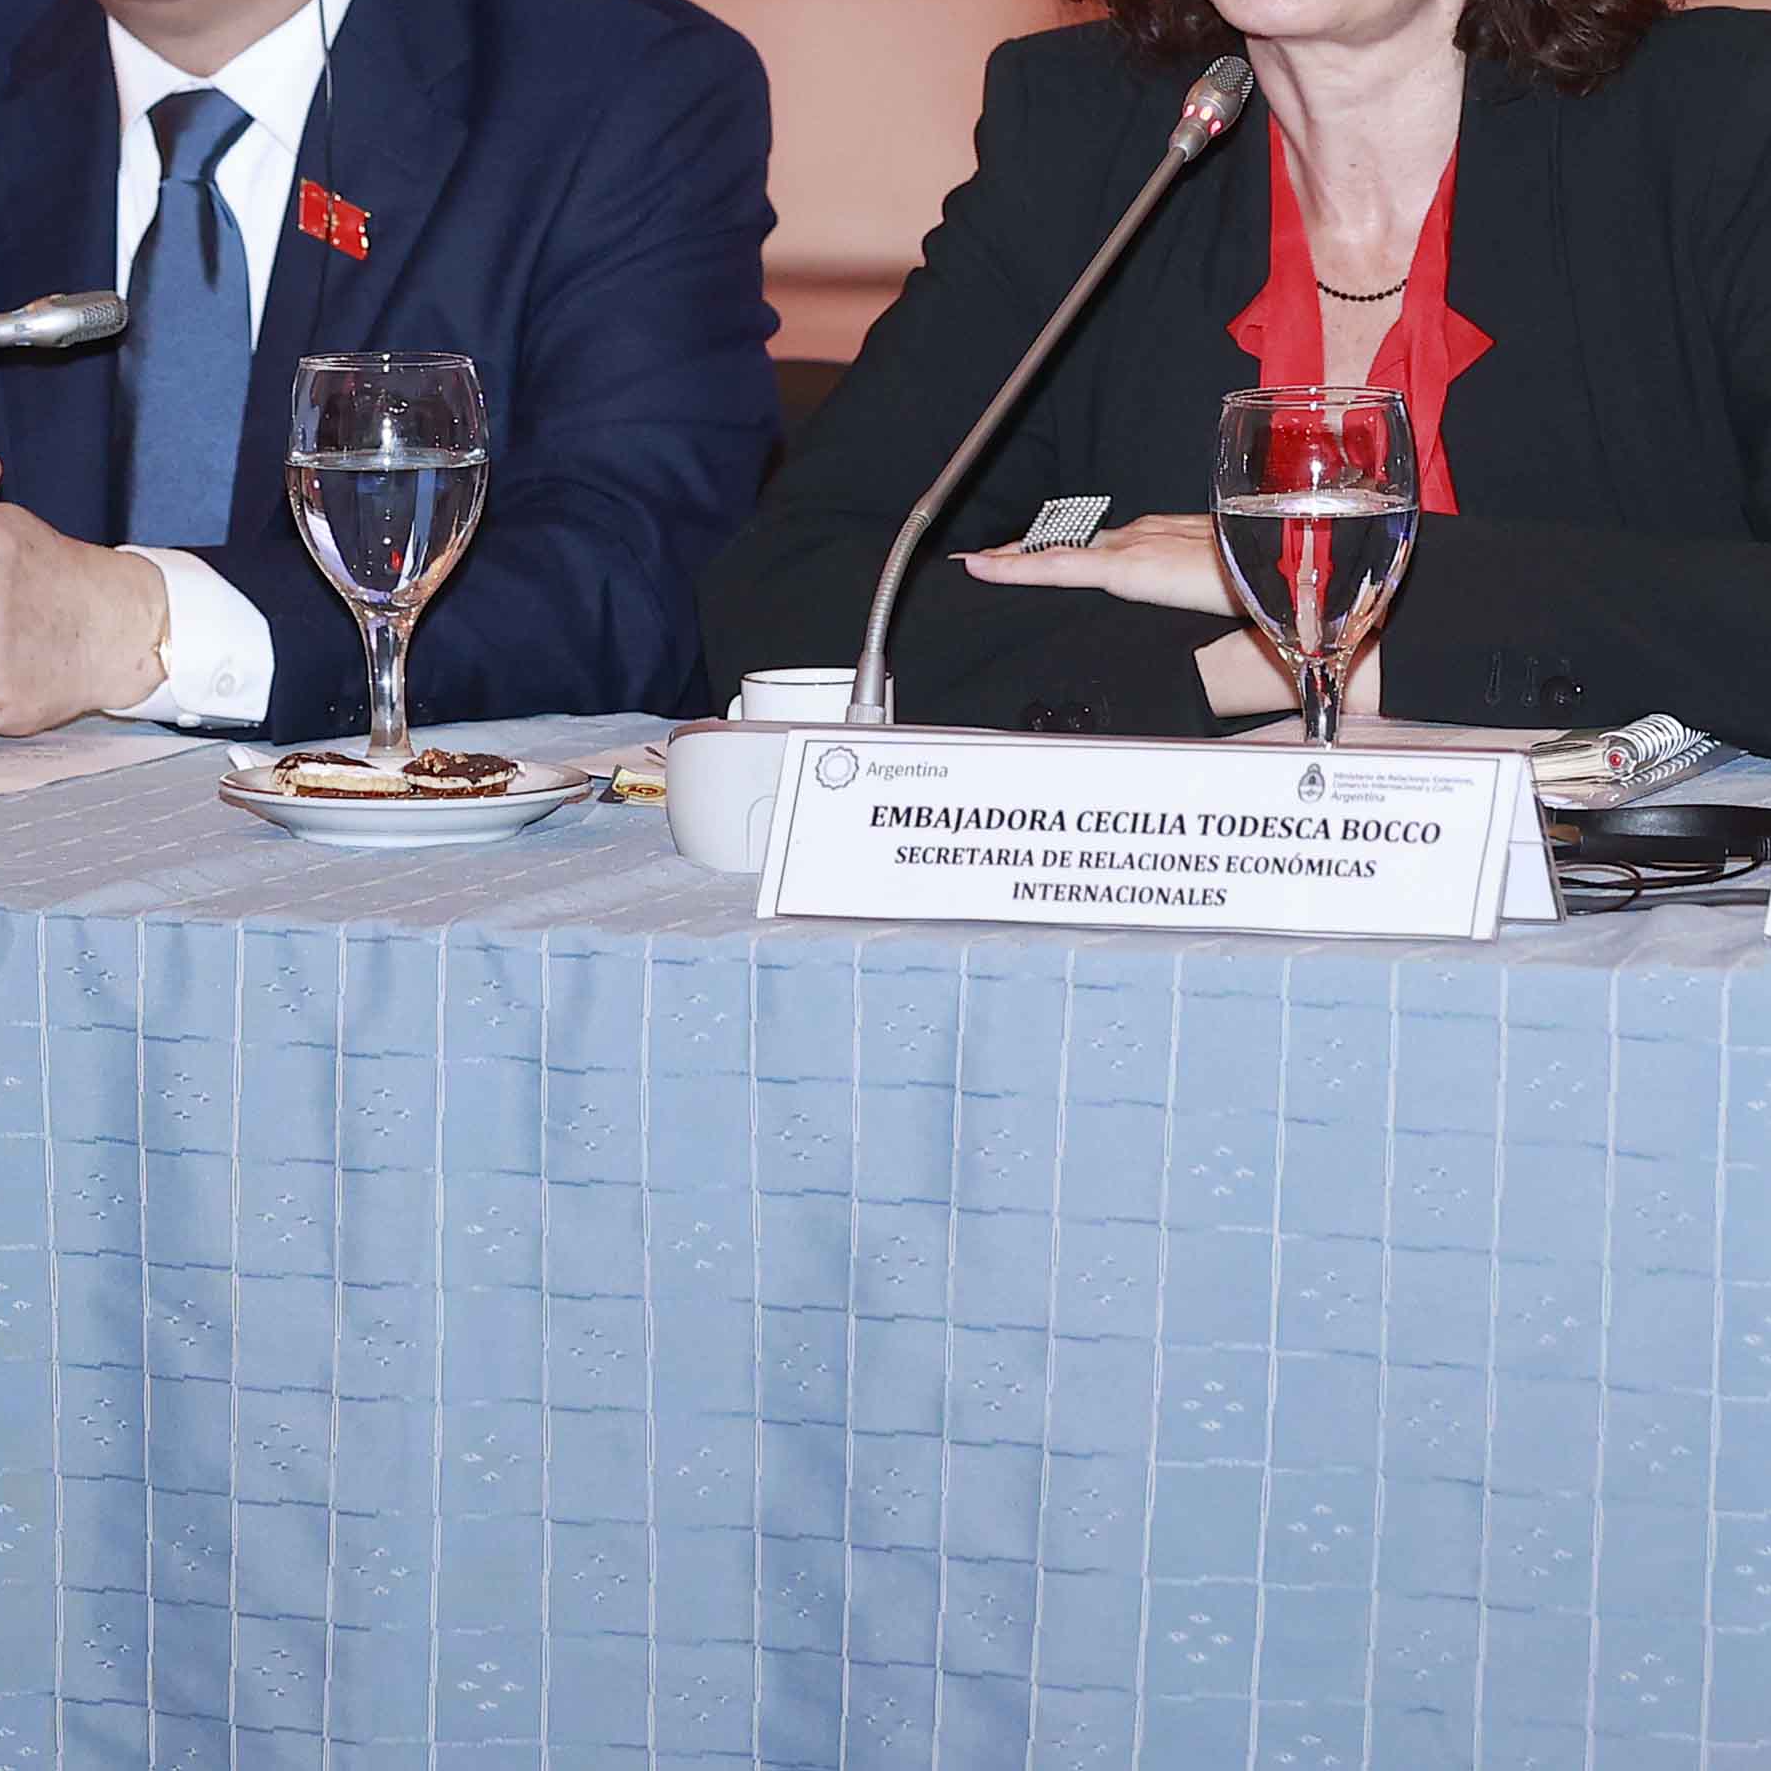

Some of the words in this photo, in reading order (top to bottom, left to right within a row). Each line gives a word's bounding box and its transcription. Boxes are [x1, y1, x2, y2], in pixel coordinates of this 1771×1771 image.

[866, 762, 948, 780] Argentina
[871, 806, 1065, 833] EMBAJADORA
[1077, 811, 1185, 835] CECILIA
[1198, 815, 1330, 839] TODESCA
[1342, 820, 1440, 843] BOCCO
[895, 847, 1033, 866] SECRETARIA
[1042, 850, 1072, 867] DE
[1079, 852, 1219, 871] RELACIONES
[1226, 856, 1375, 877] ECONÓMICAS
[1013, 882, 1226, 905] INTERNACIONALES
